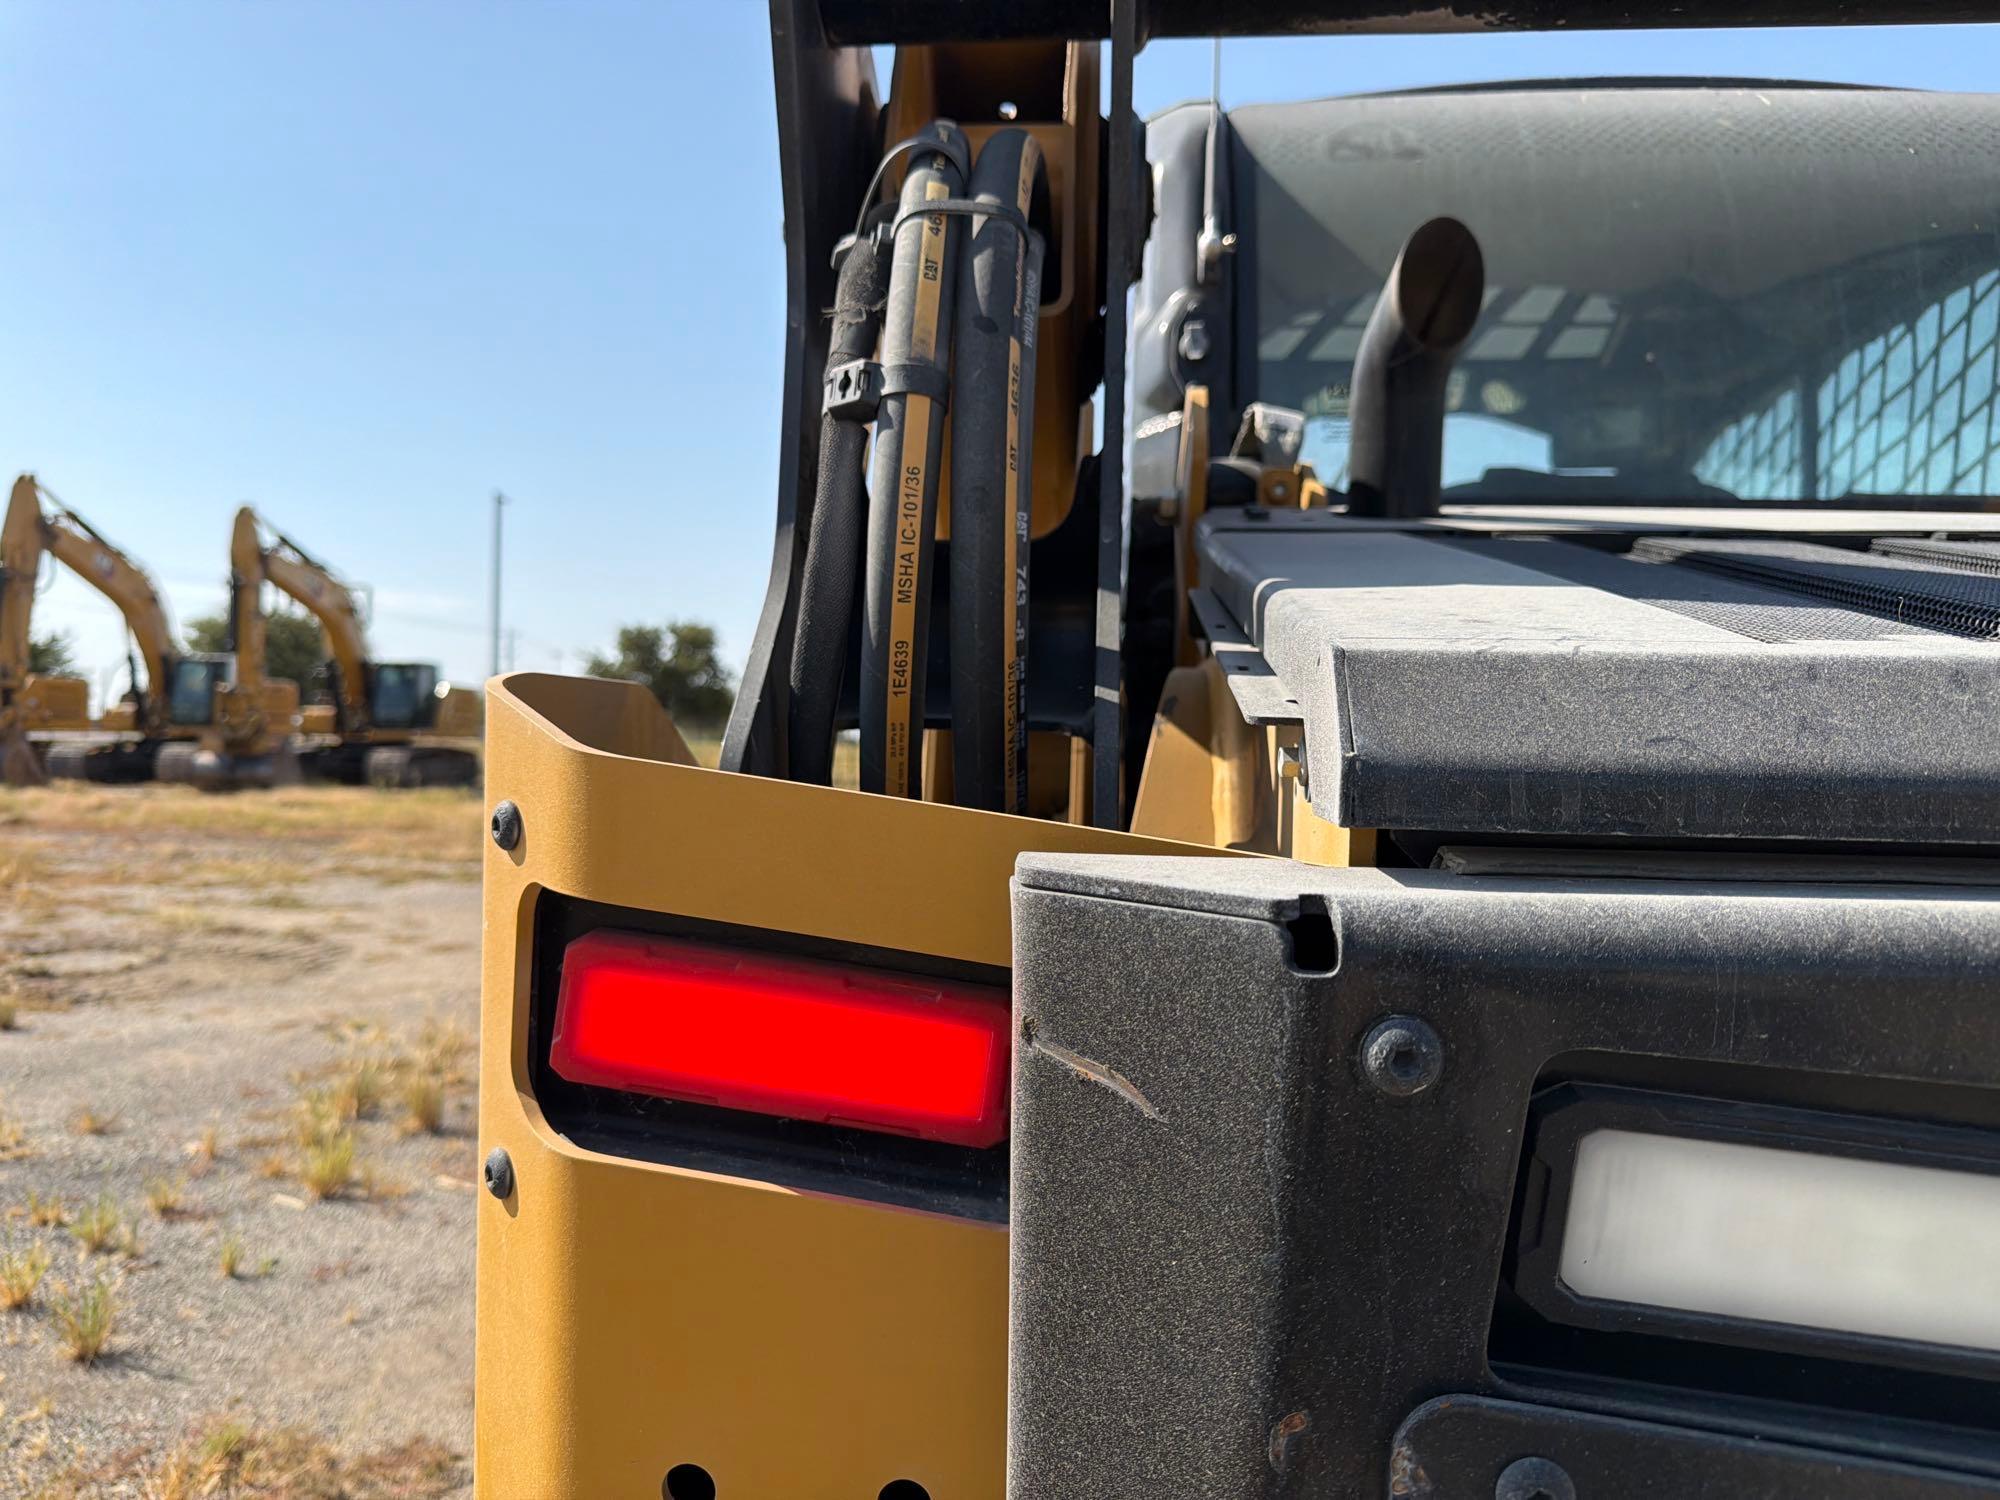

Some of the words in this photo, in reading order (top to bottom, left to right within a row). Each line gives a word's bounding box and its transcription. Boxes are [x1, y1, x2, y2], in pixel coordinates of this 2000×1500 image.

[923, 256, 939, 281] CAT
[1009, 443, 1017, 472] CAT
[901, 466, 920, 546] IC-101/36
[897, 552, 914, 604] MSHA
[892, 640, 909, 698] 1E4639
